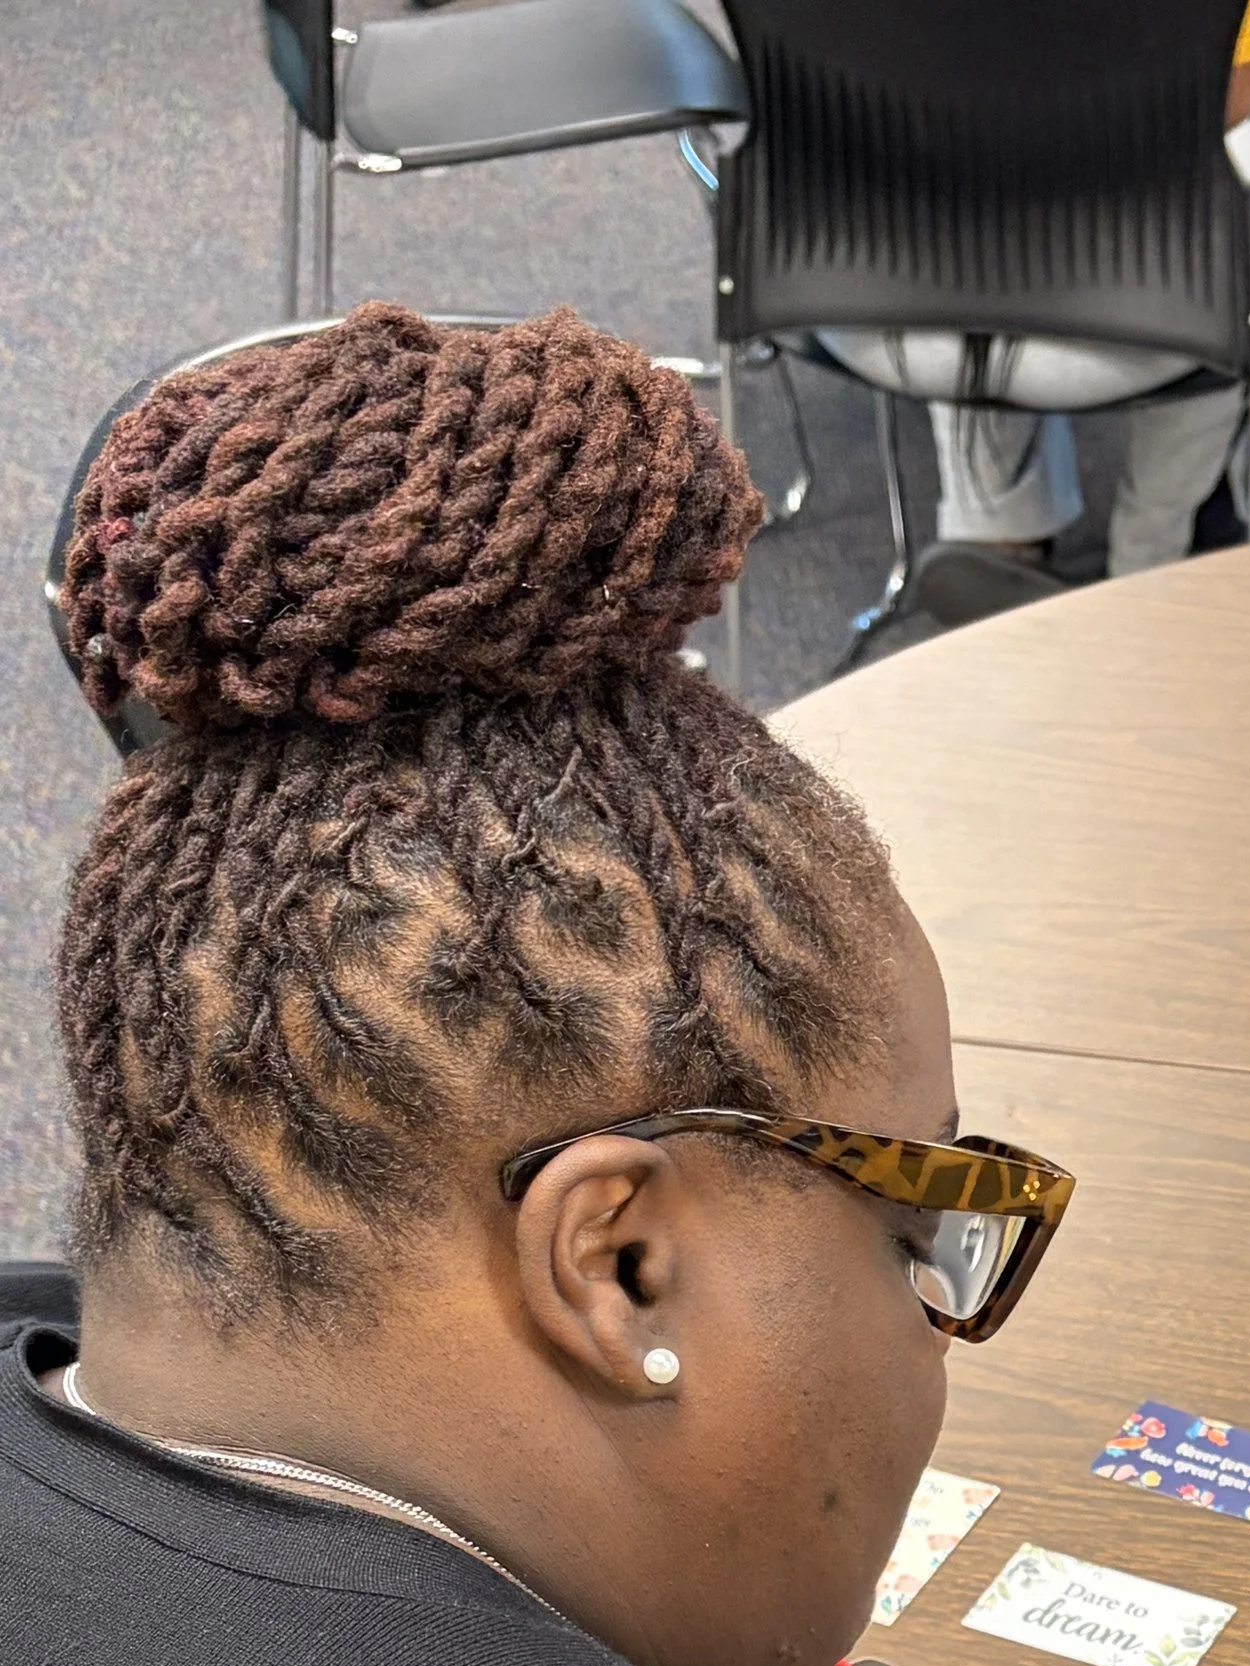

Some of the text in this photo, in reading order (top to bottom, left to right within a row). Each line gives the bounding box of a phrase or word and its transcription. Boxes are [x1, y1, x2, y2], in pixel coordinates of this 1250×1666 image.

[1139, 1447, 1174, 1468] how
[1173, 1460, 1219, 1482] great
[1217, 1473, 1249, 1491] you
[1175, 1441, 1222, 1465] Never
[1063, 1581, 1149, 1619] Dare to
[1021, 1597, 1144, 1655] dream.
